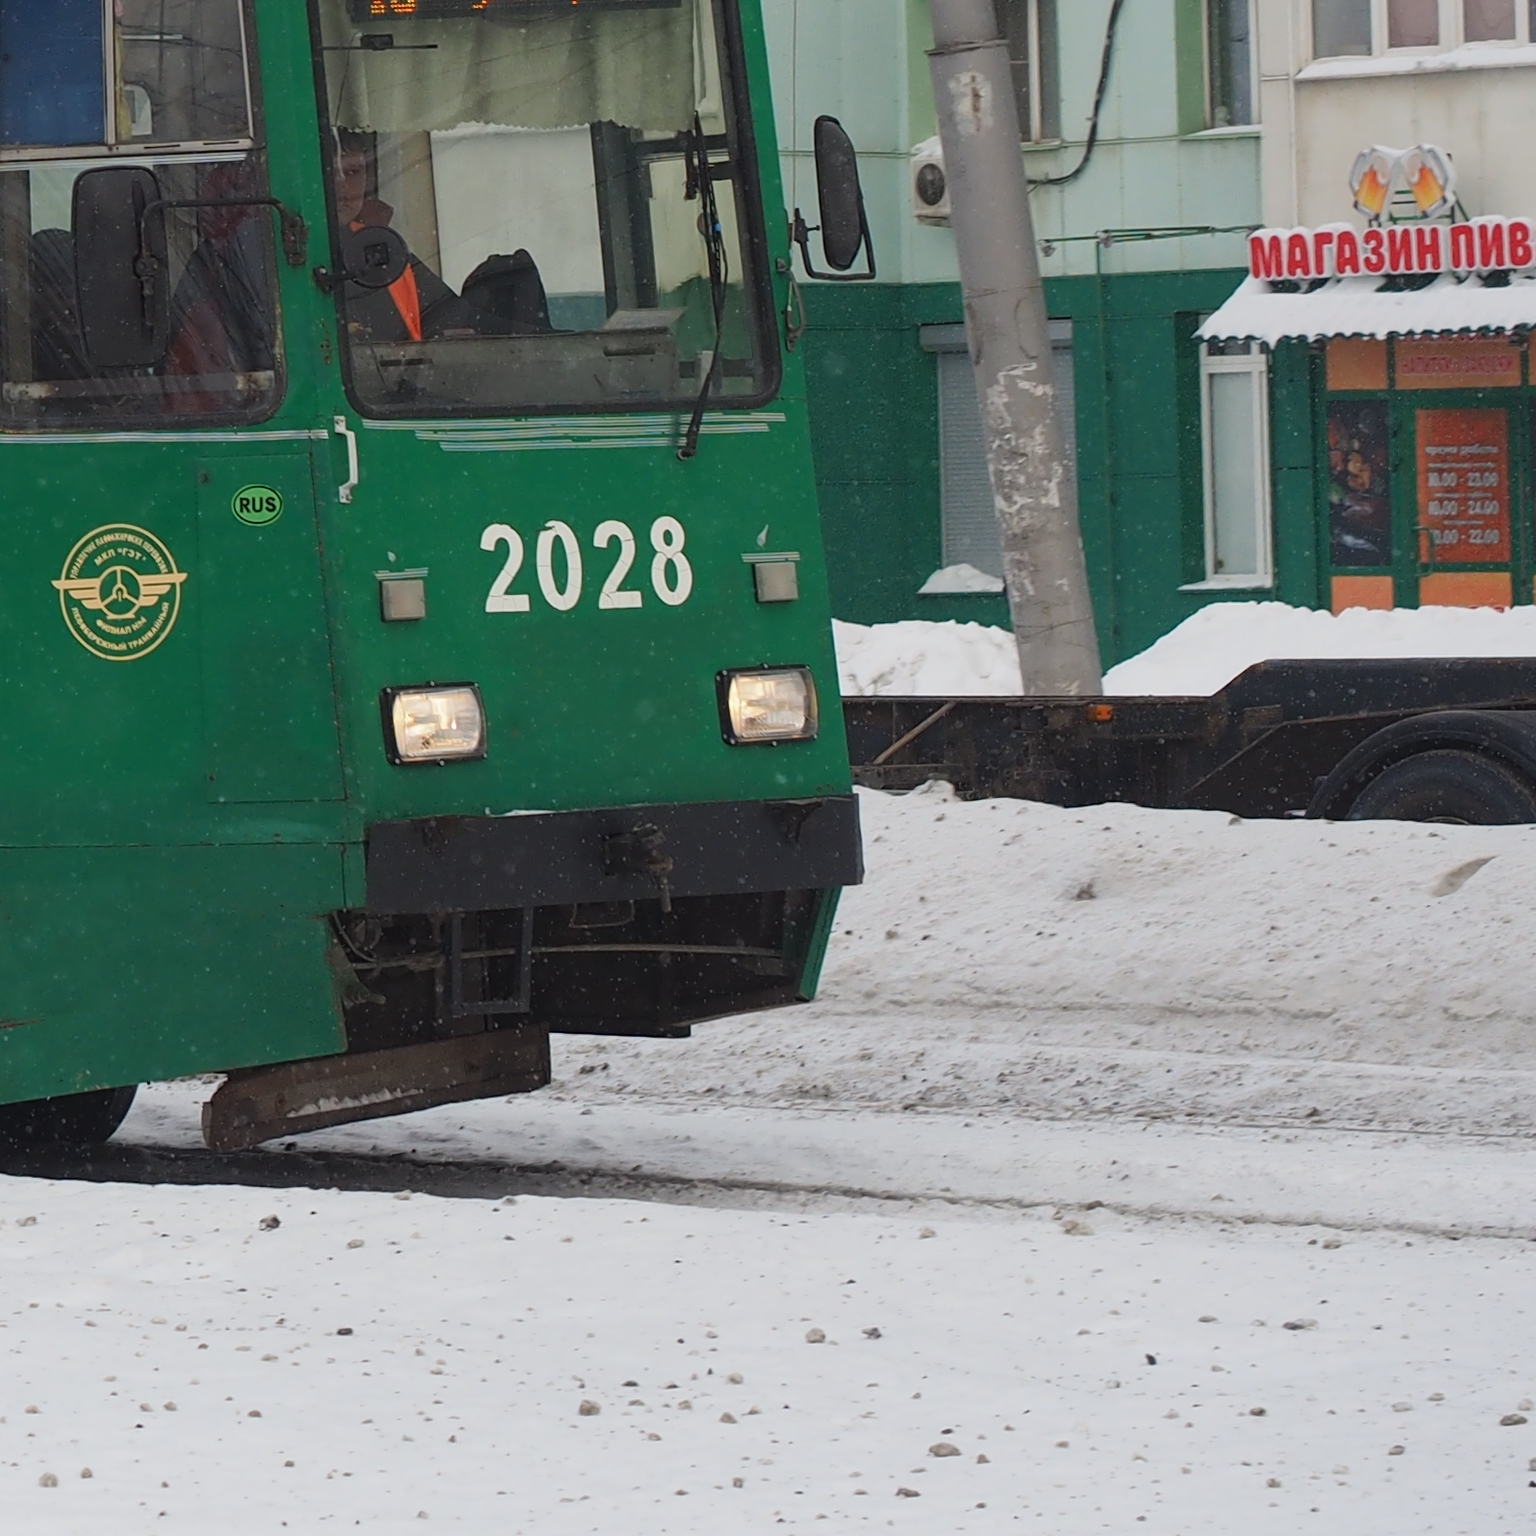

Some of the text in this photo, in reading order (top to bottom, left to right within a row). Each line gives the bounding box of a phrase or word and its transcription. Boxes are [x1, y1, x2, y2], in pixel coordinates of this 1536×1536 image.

[1250, 228, 1440, 278] МАГАЗИН
[238, 494, 276, 515] RUS
[94, 548, 116, 566] МКП
[480, 516, 694, 613] 2028
[96, 619, 132, 635] ФИЛИАЛ
